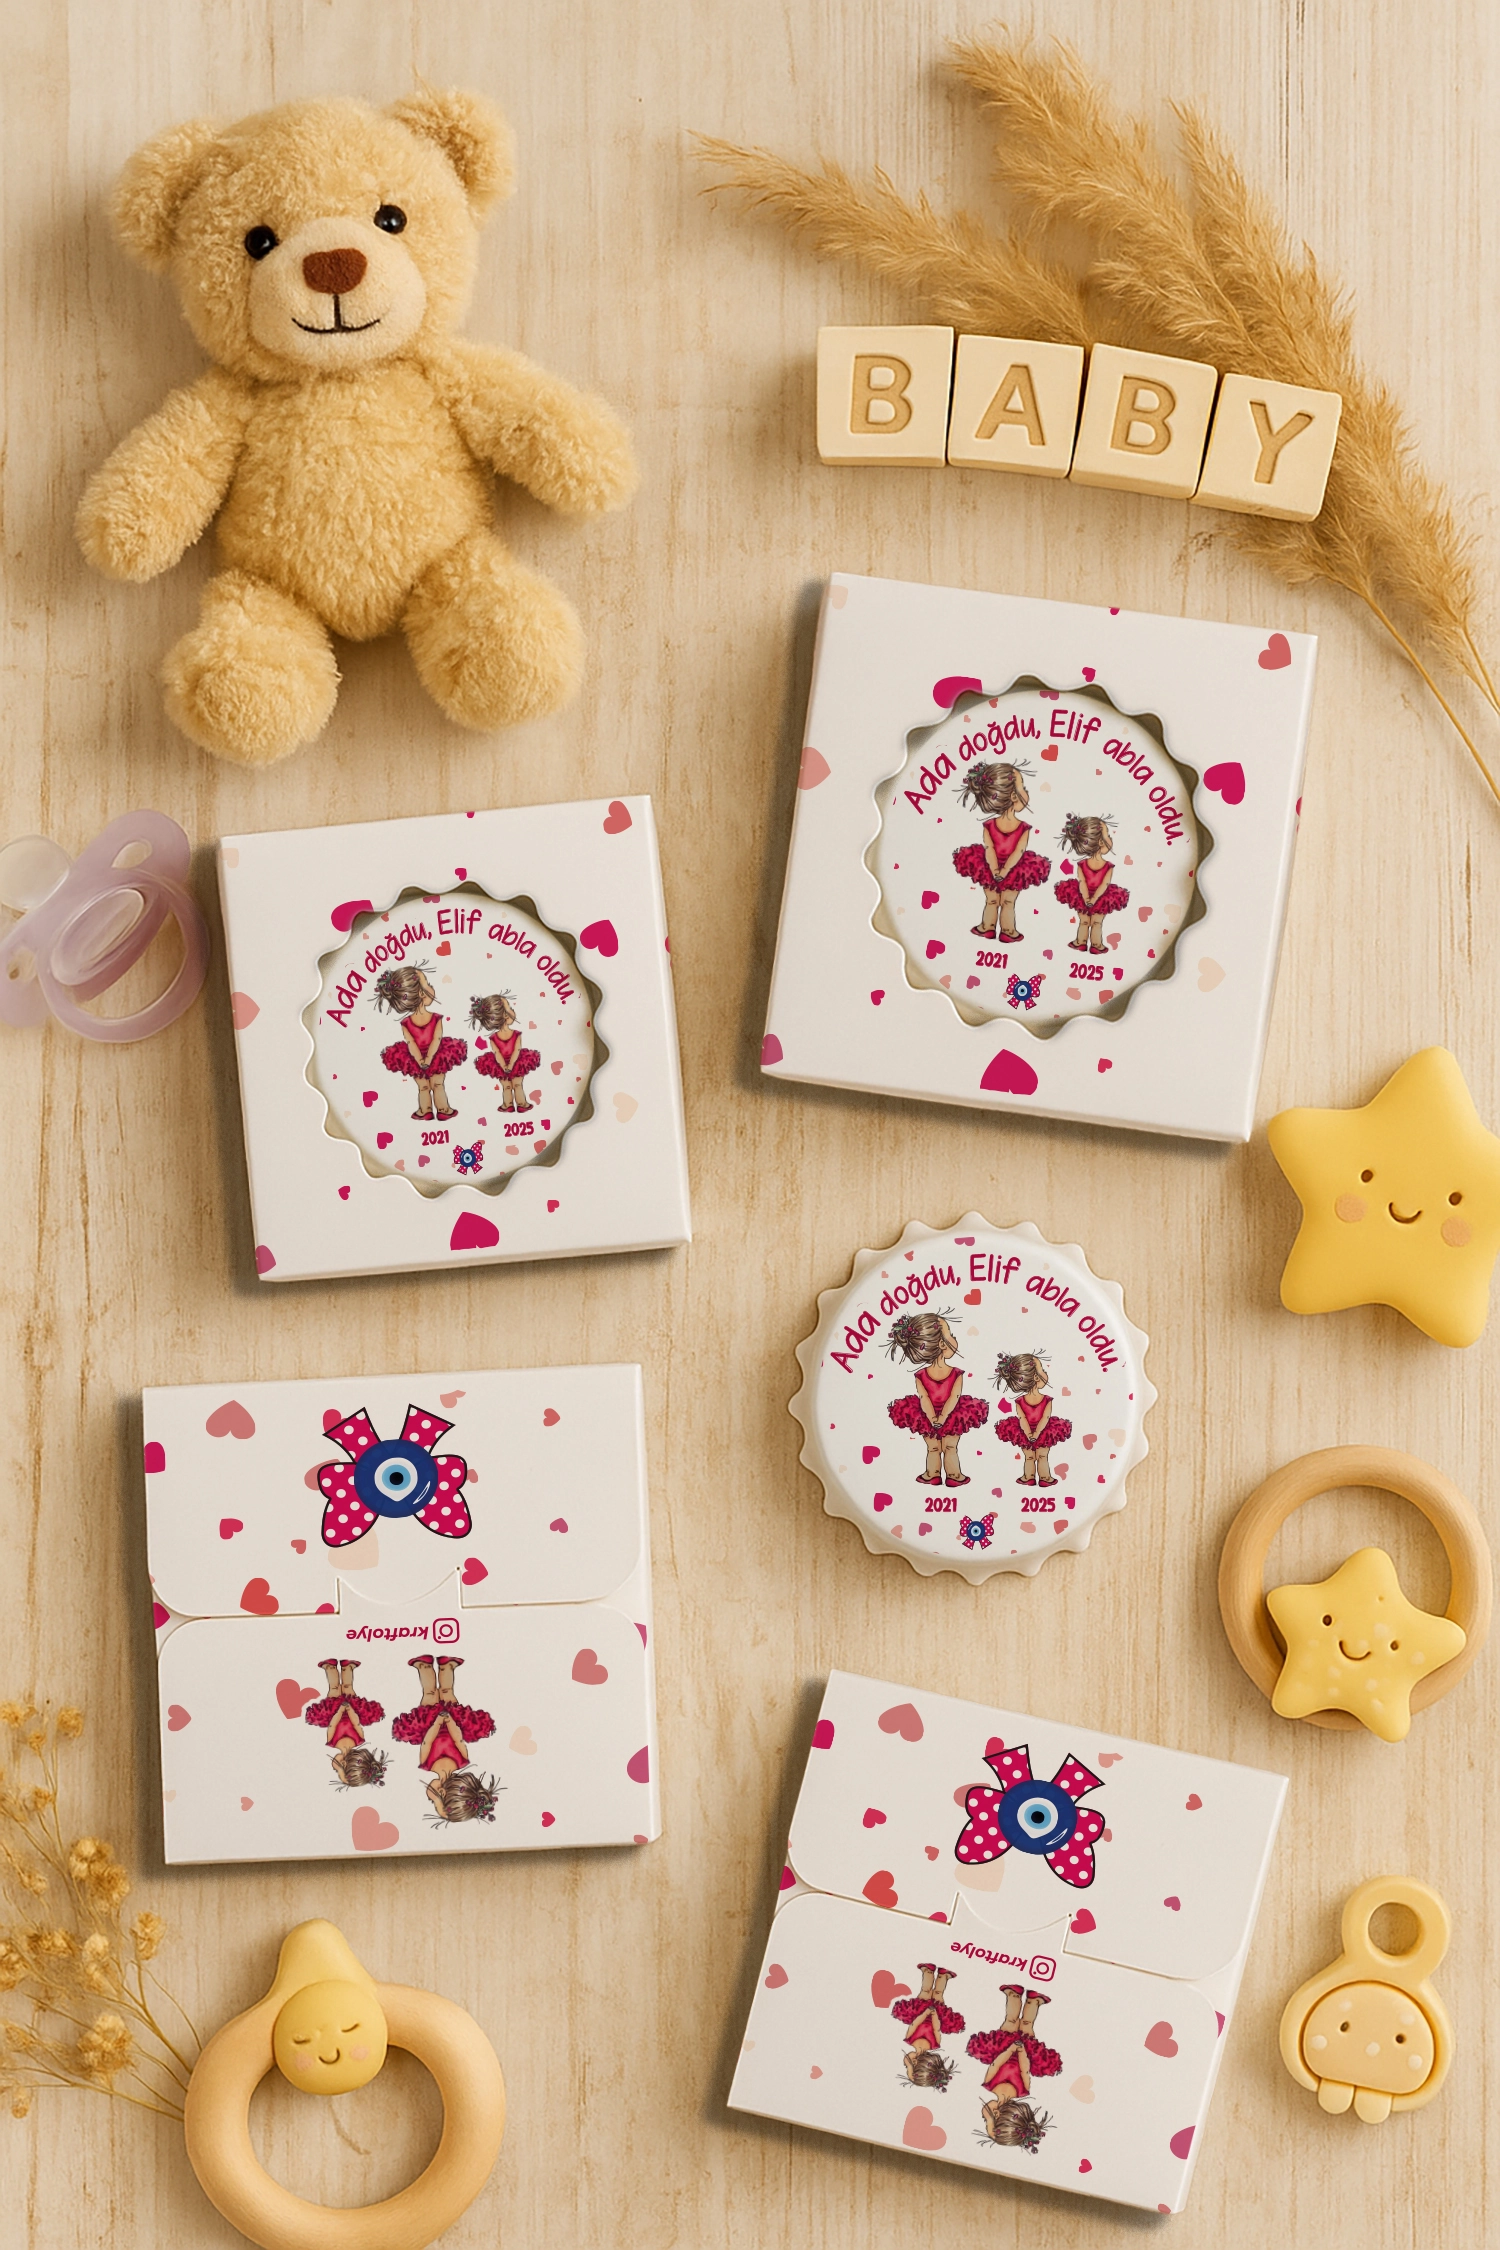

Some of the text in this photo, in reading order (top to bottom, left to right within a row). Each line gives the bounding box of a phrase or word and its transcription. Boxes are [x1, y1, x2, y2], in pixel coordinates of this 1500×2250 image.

[849, 354, 1314, 484] BABY
[903, 709, 1184, 846] Ada doğdu, Elif abla oldu.
[326, 908, 575, 1028] Ada doğdu, Elif abla oldu.
[975, 950, 1009, 969] 2021
[1068, 962, 1105, 981] 2025
[421, 1130, 450, 1146] 2021
[503, 1121, 534, 1137] 2025
[830, 1253, 1118, 1374] Ada doğdu, Elif abla oldu.
[924, 1497, 958, 1513] 2021
[1020, 1497, 1056, 1513] 2025
[346, 1625, 429, 1643] kraftolye
[950, 1942, 1028, 1971] kraftolye
